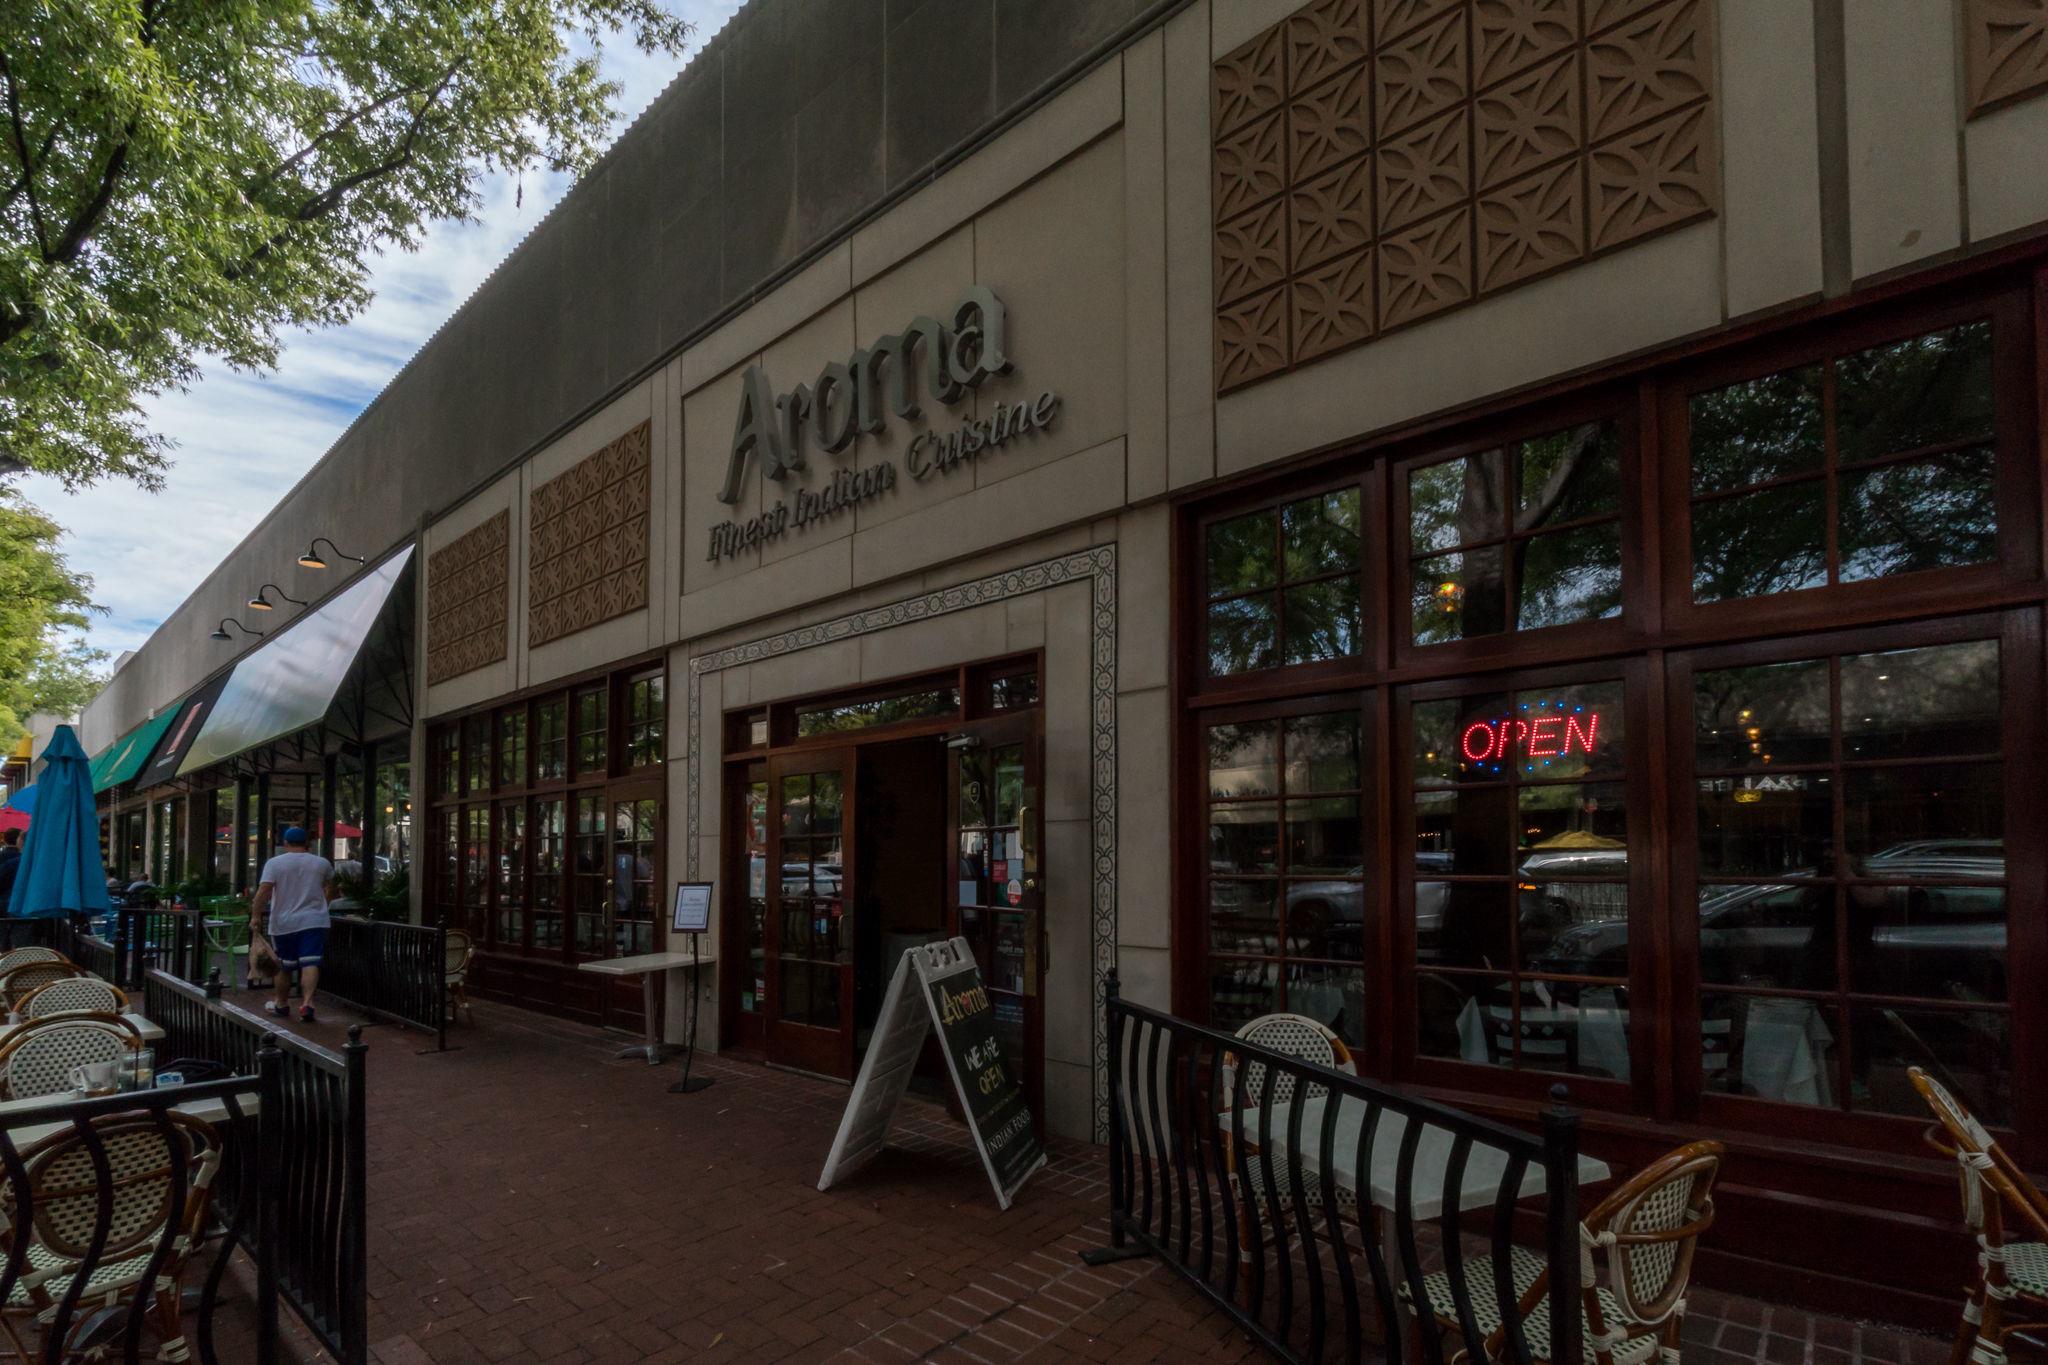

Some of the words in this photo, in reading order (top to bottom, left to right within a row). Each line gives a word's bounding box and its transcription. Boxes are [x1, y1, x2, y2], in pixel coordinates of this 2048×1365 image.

[716, 284, 1015, 505] Aroma
[706, 501, 788, 561] Finest
[790, 460, 896, 528] Indian
[905, 390, 1062, 481] Cuisine
[1462, 713, 1599, 761] OPEN
[941, 984, 990, 1026] Aroma
[964, 1045, 983, 1072] WE
[982, 1036, 1000, 1061] ARE
[979, 1063, 1006, 1095] OPEN
[985, 1123, 1014, 1156] INDIAN
[1012, 1107, 1033, 1132] FOOD
